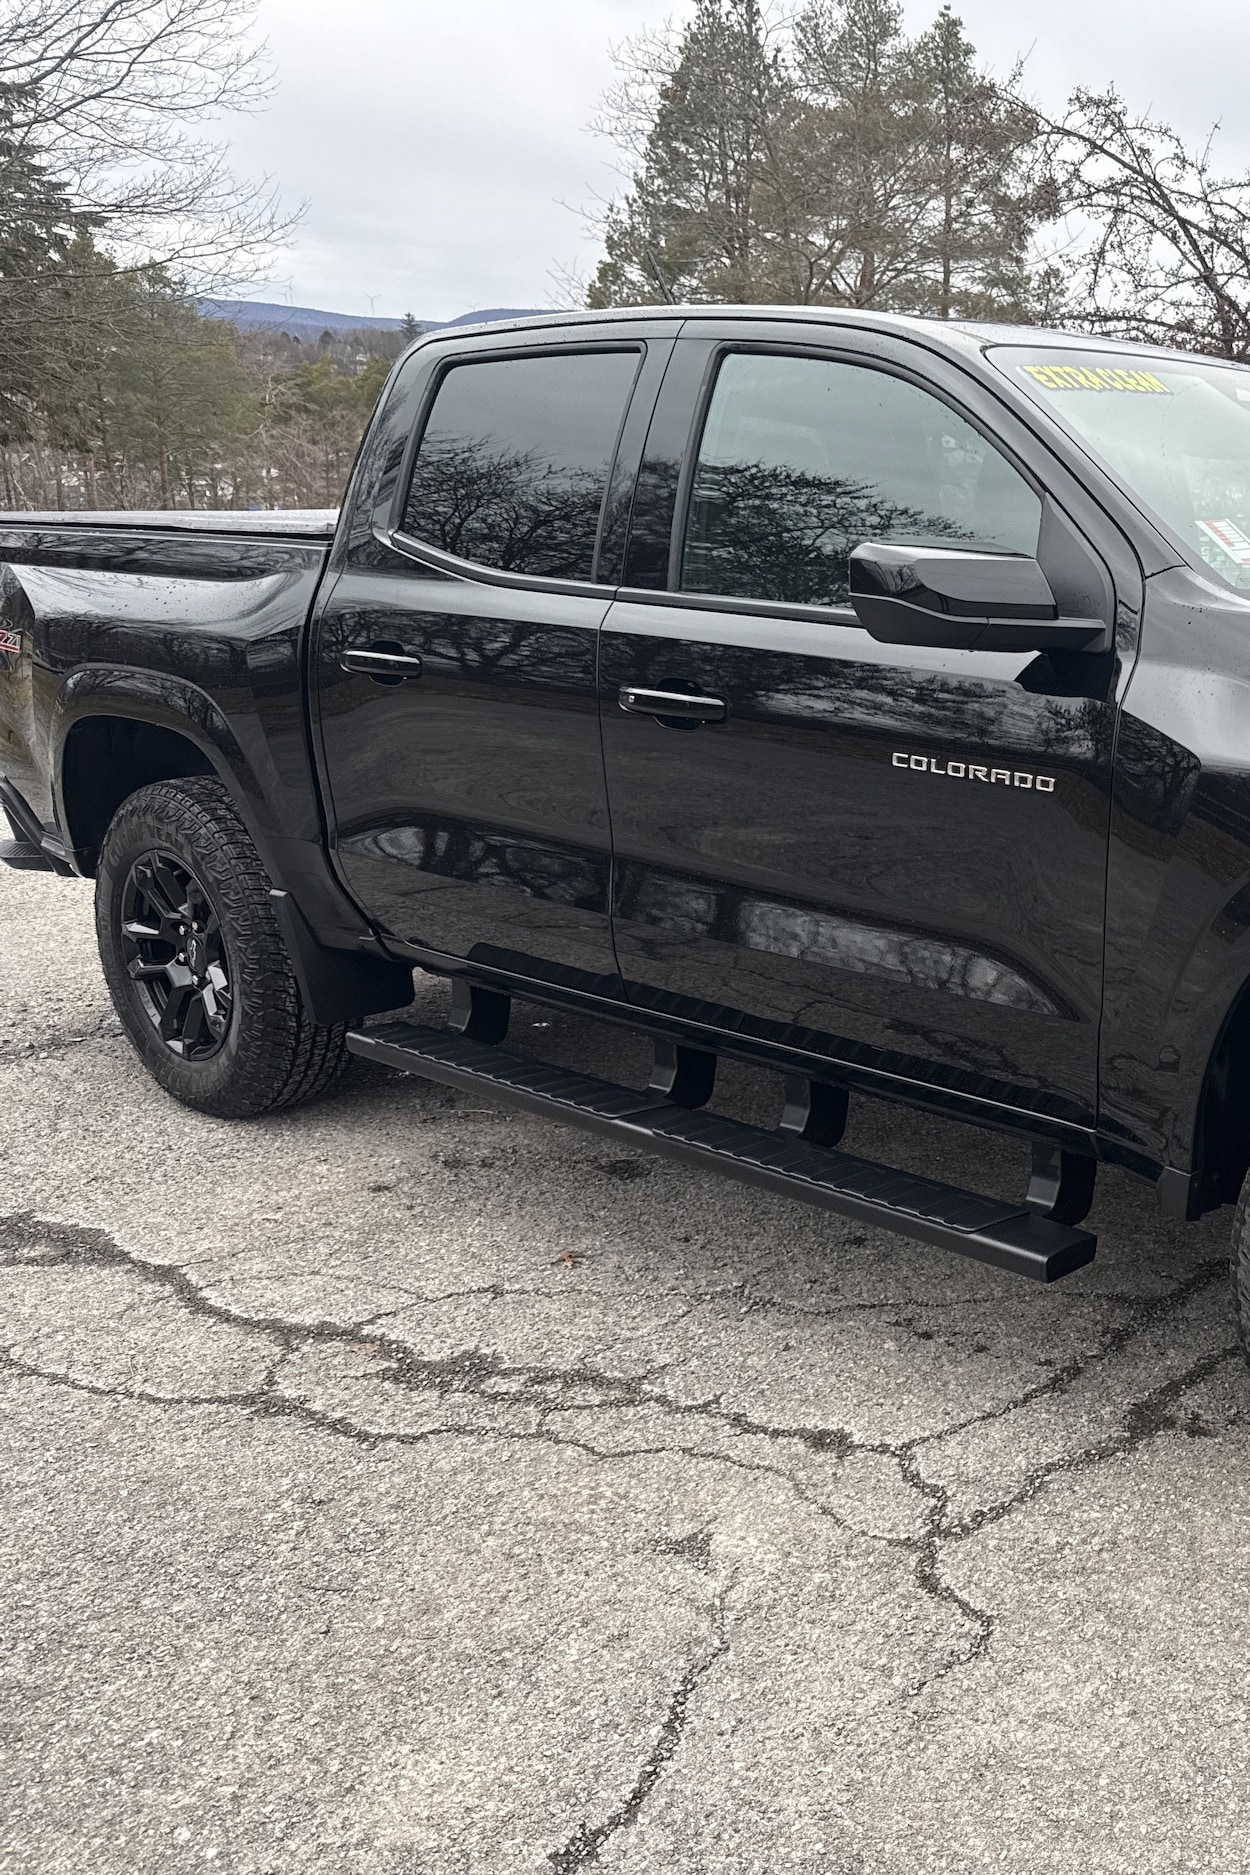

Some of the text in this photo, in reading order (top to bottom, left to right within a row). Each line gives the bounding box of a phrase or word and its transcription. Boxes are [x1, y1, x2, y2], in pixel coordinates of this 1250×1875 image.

[1023, 365, 1174, 395] EXTRA CLEAN
[892, 752, 1056, 793] COLORADO
